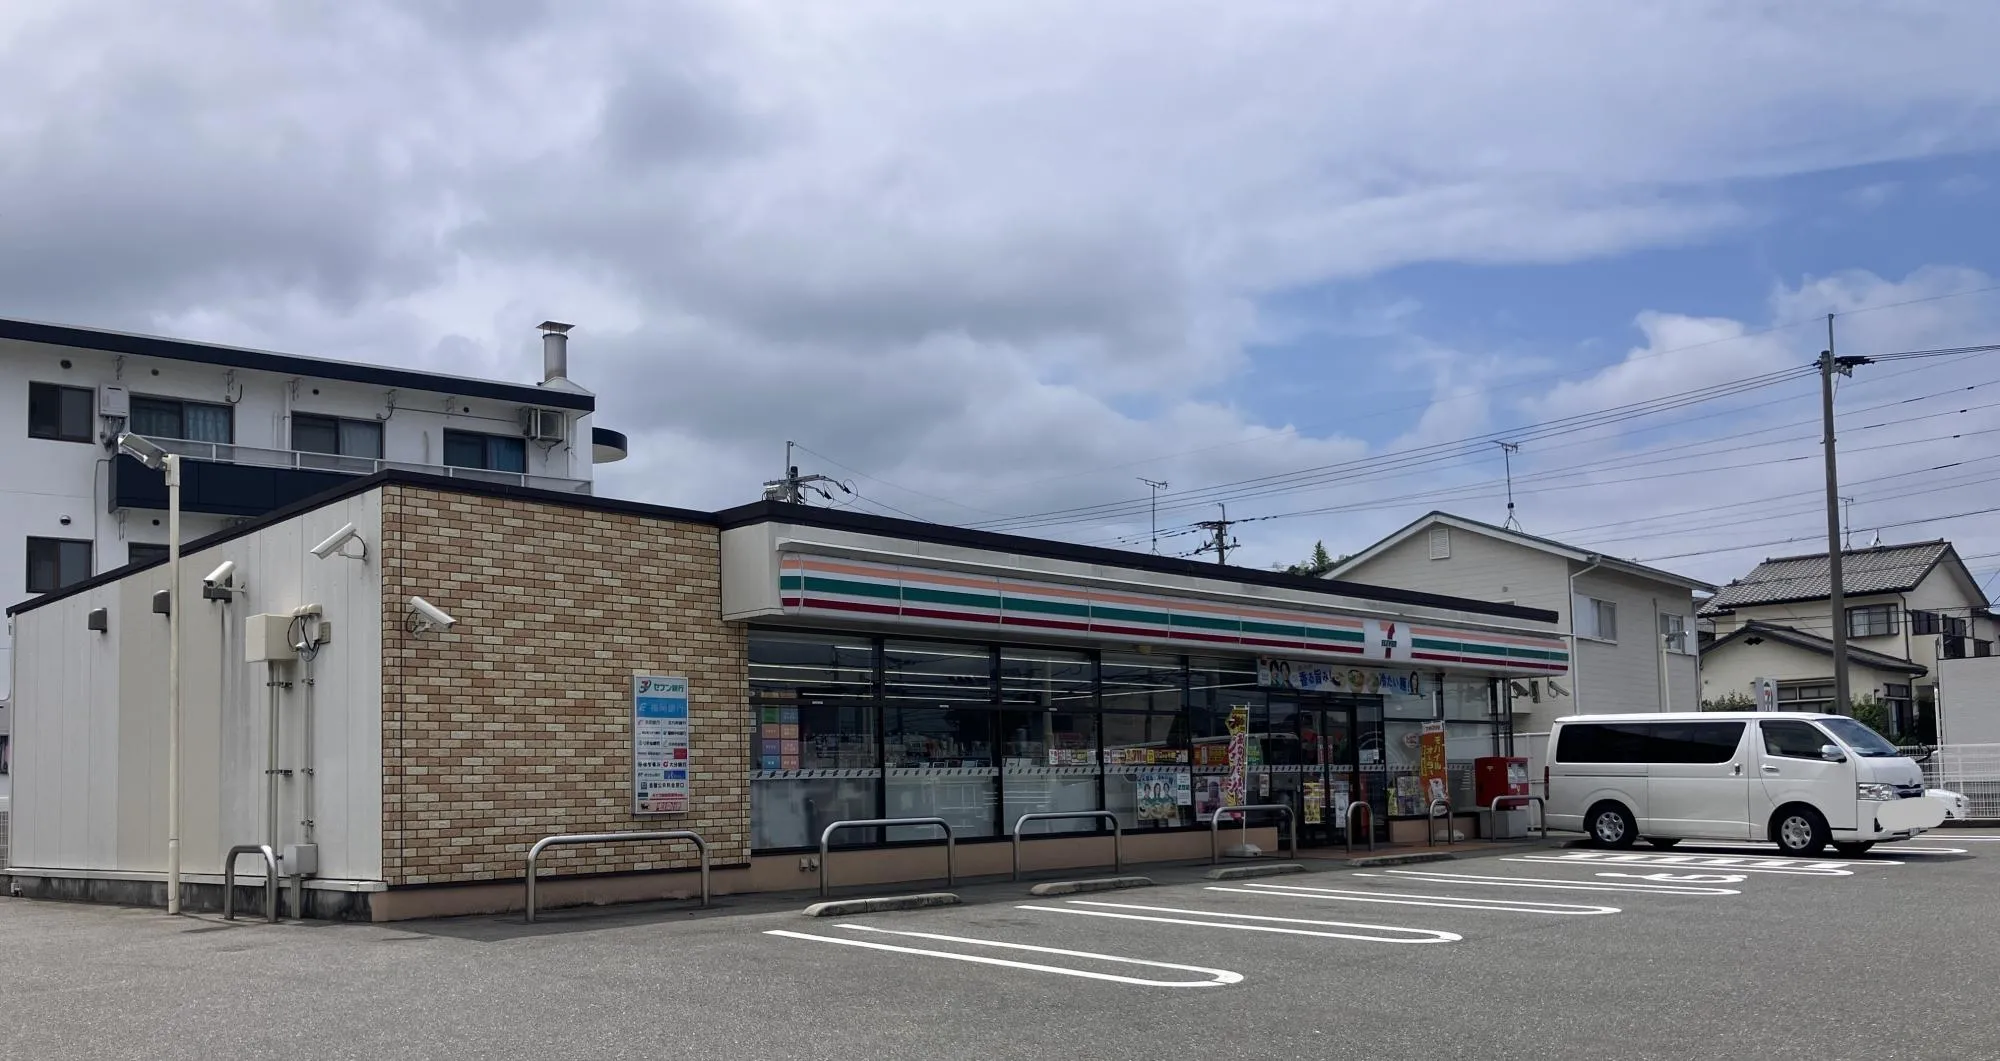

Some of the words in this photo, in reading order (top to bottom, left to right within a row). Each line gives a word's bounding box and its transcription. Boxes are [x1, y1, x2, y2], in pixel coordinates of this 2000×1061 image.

[653, 683, 685, 693] セブン銀行
